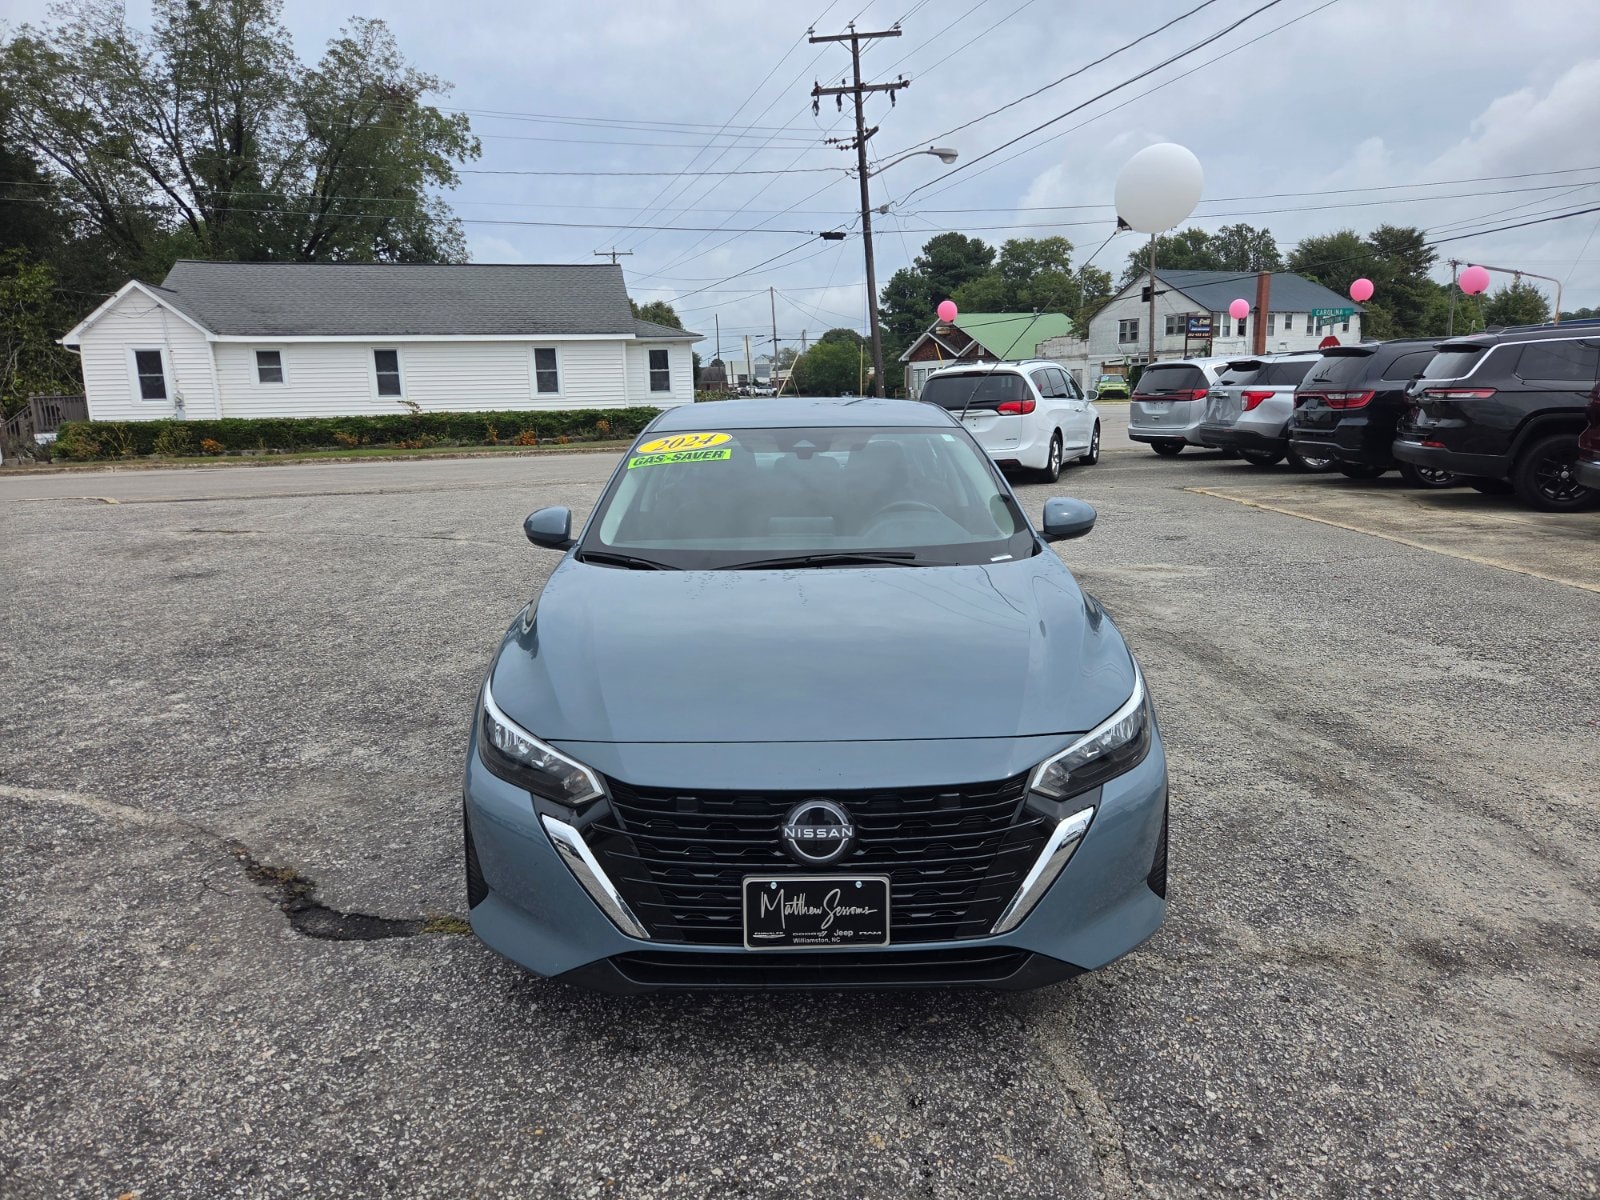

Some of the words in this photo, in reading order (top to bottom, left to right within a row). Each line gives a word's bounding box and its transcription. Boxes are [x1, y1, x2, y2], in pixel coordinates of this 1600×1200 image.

[652, 433, 717, 451] 2024
[784, 827, 852, 838] NISSAN
[761, 888, 822, 929] Matthew
[833, 929, 854, 937] Jeep
